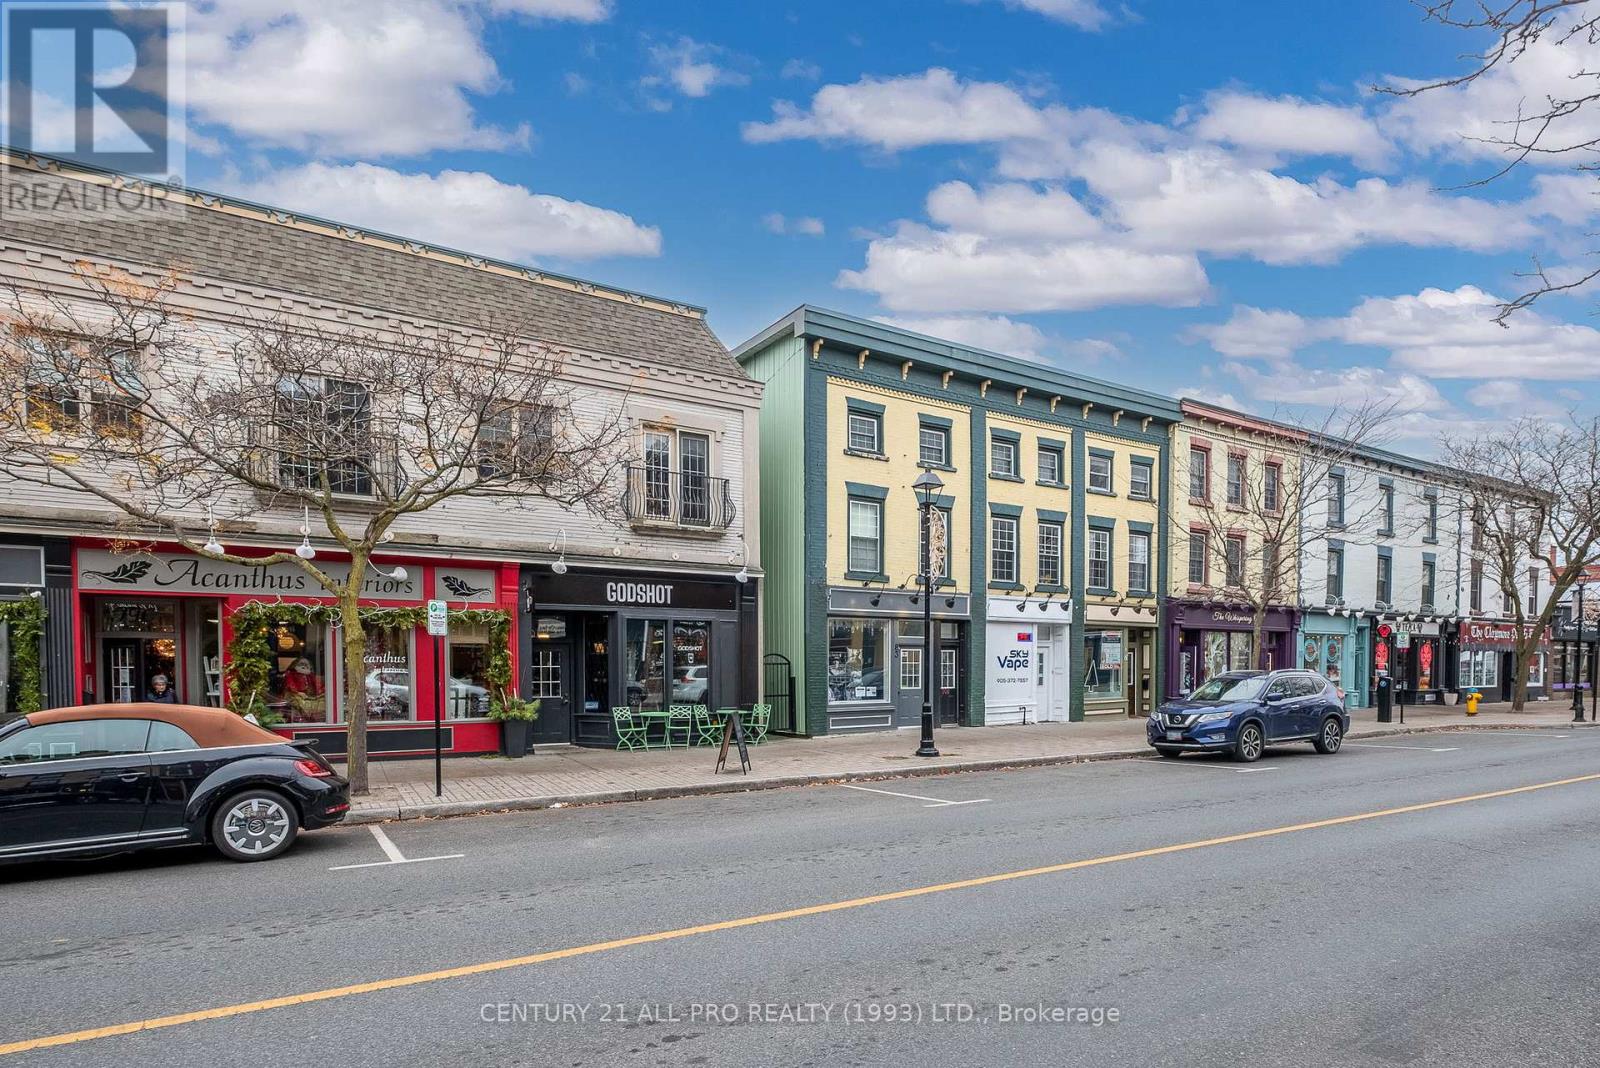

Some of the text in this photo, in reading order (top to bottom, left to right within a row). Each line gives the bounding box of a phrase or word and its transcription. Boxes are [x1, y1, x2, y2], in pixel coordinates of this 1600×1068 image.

[154, 559, 413, 593] Acanthus inriors
[606, 582, 673, 604] GODSHOT
[363, 651, 406, 663] canthus
[997, 655, 1029, 671] Vape
